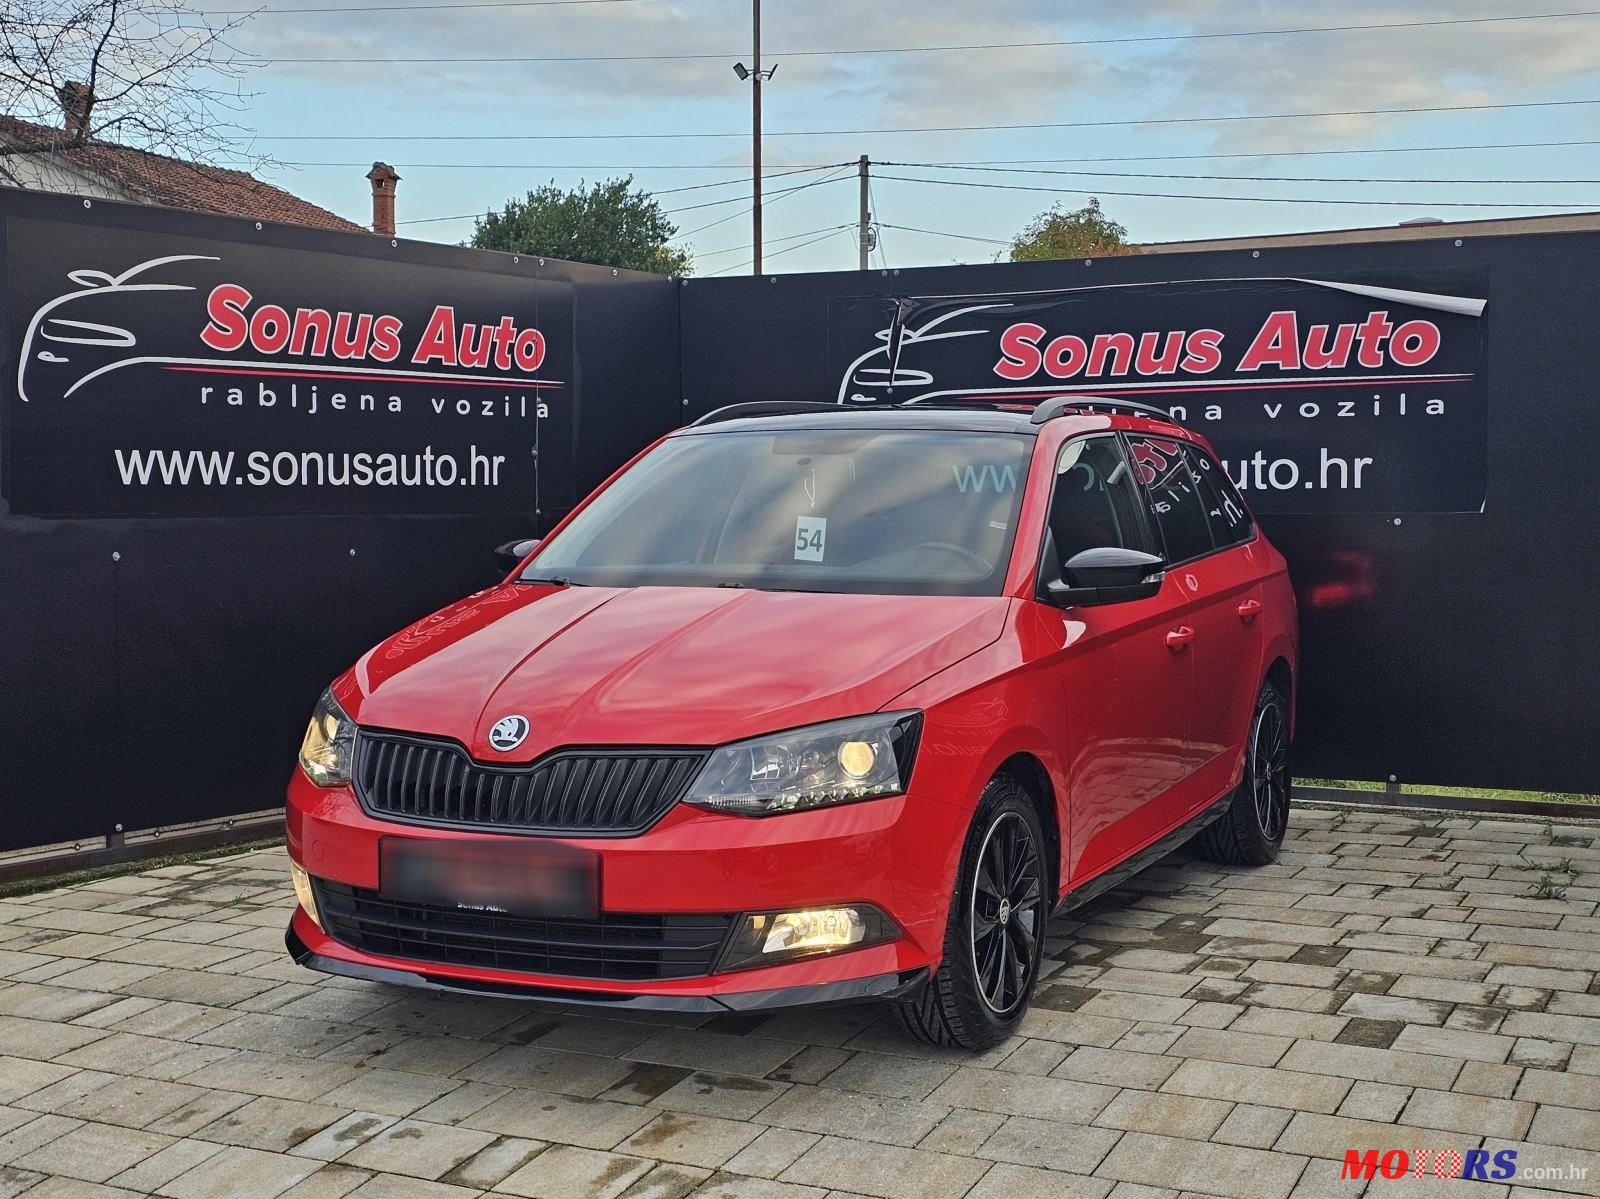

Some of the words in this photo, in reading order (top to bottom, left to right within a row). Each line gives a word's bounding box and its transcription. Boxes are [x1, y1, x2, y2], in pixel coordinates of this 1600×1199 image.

[200, 283, 403, 363] Sonus
[410, 305, 546, 372] Auto
[993, 322, 1225, 381] Sonus
[1236, 310, 1441, 371] Auto
[201, 382, 402, 414] rabljena
[431, 395, 549, 419] vozila
[1263, 393, 1445, 420] vozila
[114, 444, 506, 486] www.sonusauto.hr
[796, 527, 823, 553] 54
